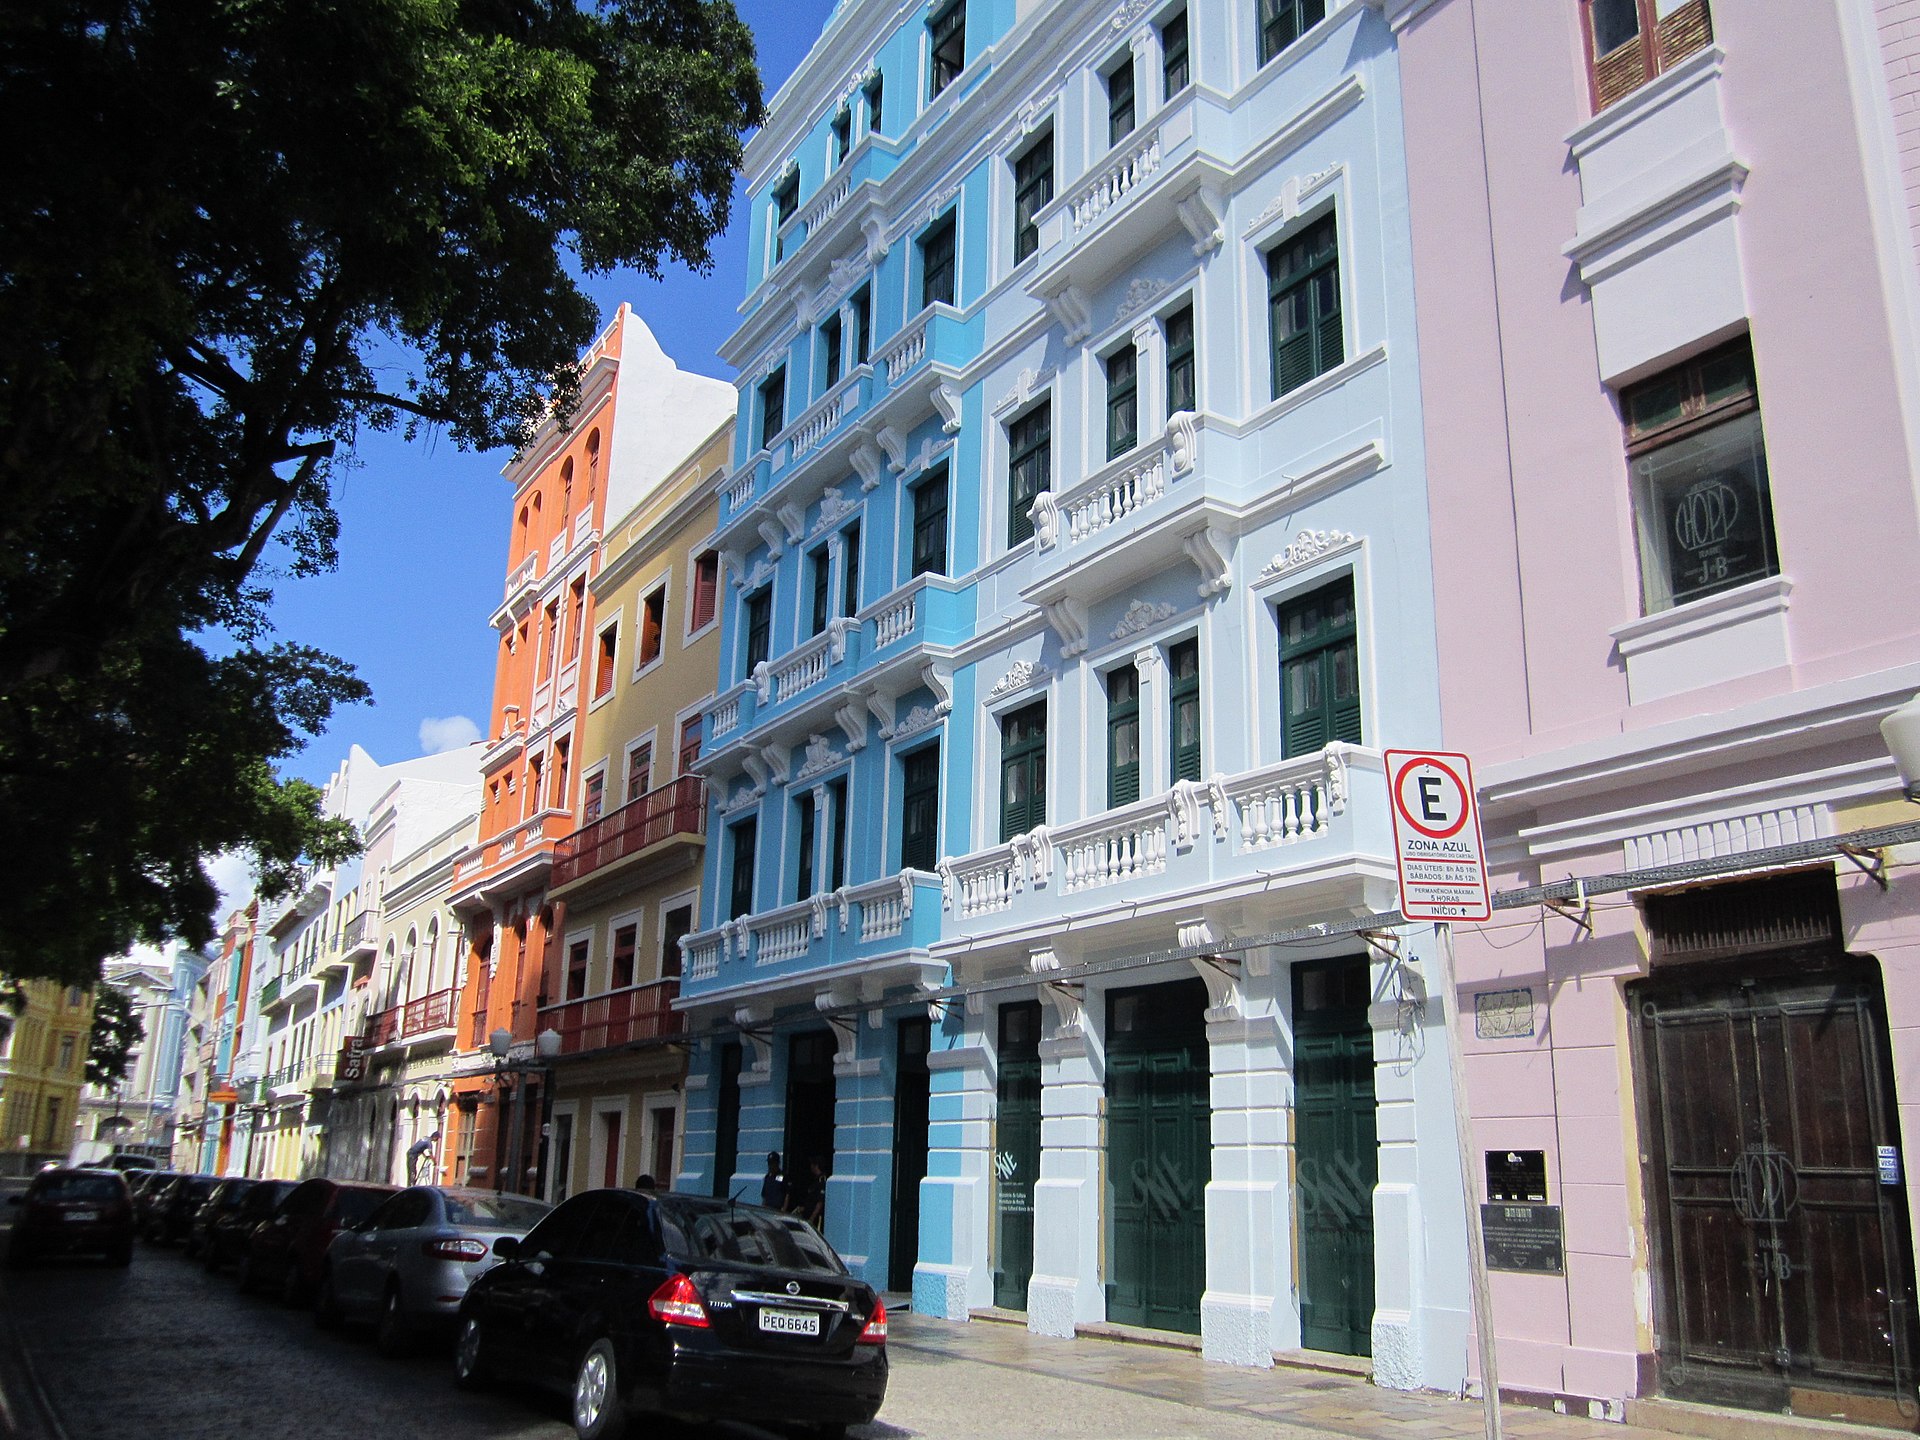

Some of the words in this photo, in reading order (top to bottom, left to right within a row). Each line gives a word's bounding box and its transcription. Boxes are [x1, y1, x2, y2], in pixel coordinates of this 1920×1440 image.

[1418, 776, 1447, 821] E
[1407, 840, 1440, 851] ZONA
[1442, 841, 1471, 853] AZUL
[1407, 864, 1423, 872] DIAS
[1414, 887, 1453, 895] PERMANÊNCIA
[1431, 905, 1458, 916] INÍCIO
[1880, 1147, 1895, 1155] VISA
[708, 1300, 733, 1309] TIIDA
